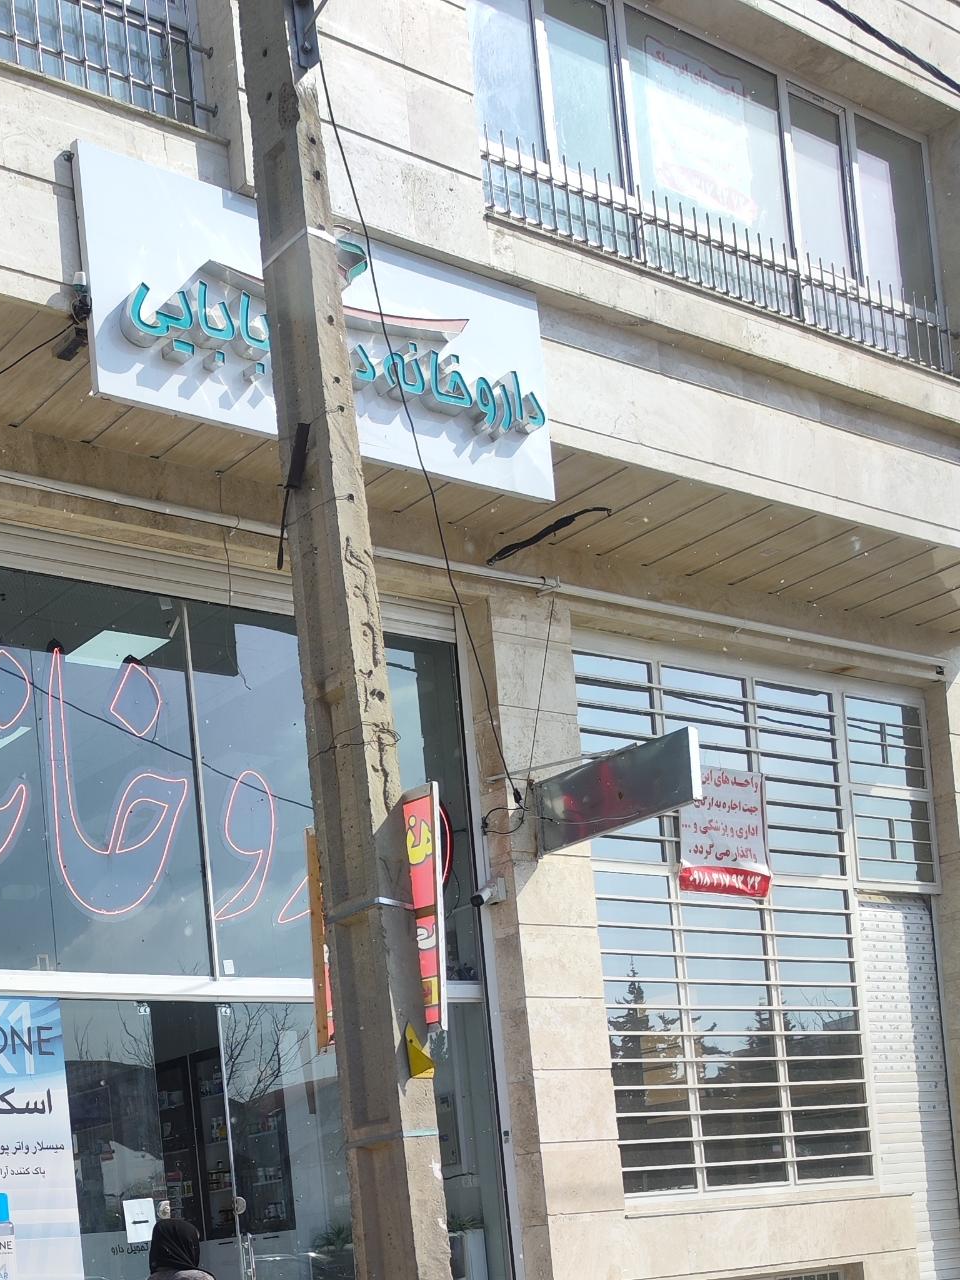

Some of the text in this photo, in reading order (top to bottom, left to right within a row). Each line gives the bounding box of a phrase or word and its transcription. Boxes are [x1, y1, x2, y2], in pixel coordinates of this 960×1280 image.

[385, 341, 546, 431] داروخانه
[714, 771, 729, 787] های
[714, 800, 722, 811] به
[722, 799, 741, 813] اجاره
[742, 803, 758, 816] جهت
[693, 822, 698, 833] و
[700, 819, 728, 837] پزشکی
[730, 826, 735, 837] و
[736, 824, 758, 839] اداری
[715, 849, 730, 860] می
[731, 846, 757, 863] واگذار
[12, 1141, 30, 1155] واتر
[32, 1141, 65, 1154] میسلار
[110, 1244, 124, 1256] دارو
